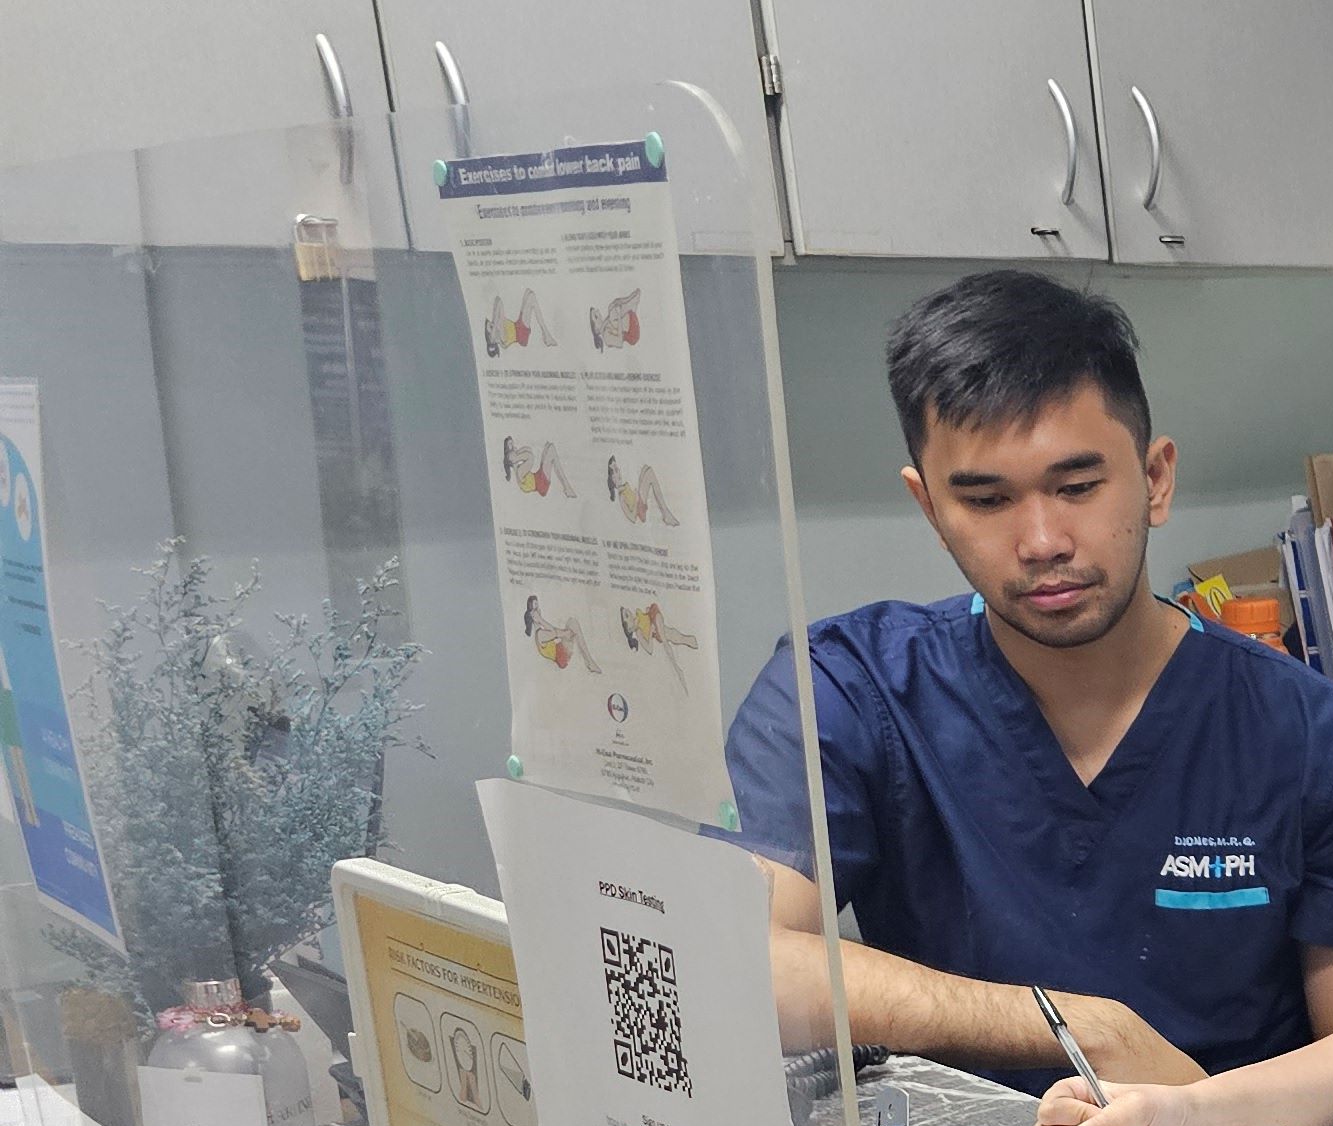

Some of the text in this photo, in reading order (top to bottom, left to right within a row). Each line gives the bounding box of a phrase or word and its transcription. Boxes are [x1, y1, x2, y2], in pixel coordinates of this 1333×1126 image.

[459, 165, 512, 186] Exercises
[514, 164, 526, 180] to
[555, 158, 584, 177] lower
[585, 154, 614, 172] back
[617, 152, 641, 176] pain
[599, 880, 665, 914] PPD Skin Testing
[406, 954, 441, 979] FACTORS
[442, 968, 459, 985] FOR
[460, 974, 522, 1009] HYPERTENSIO
